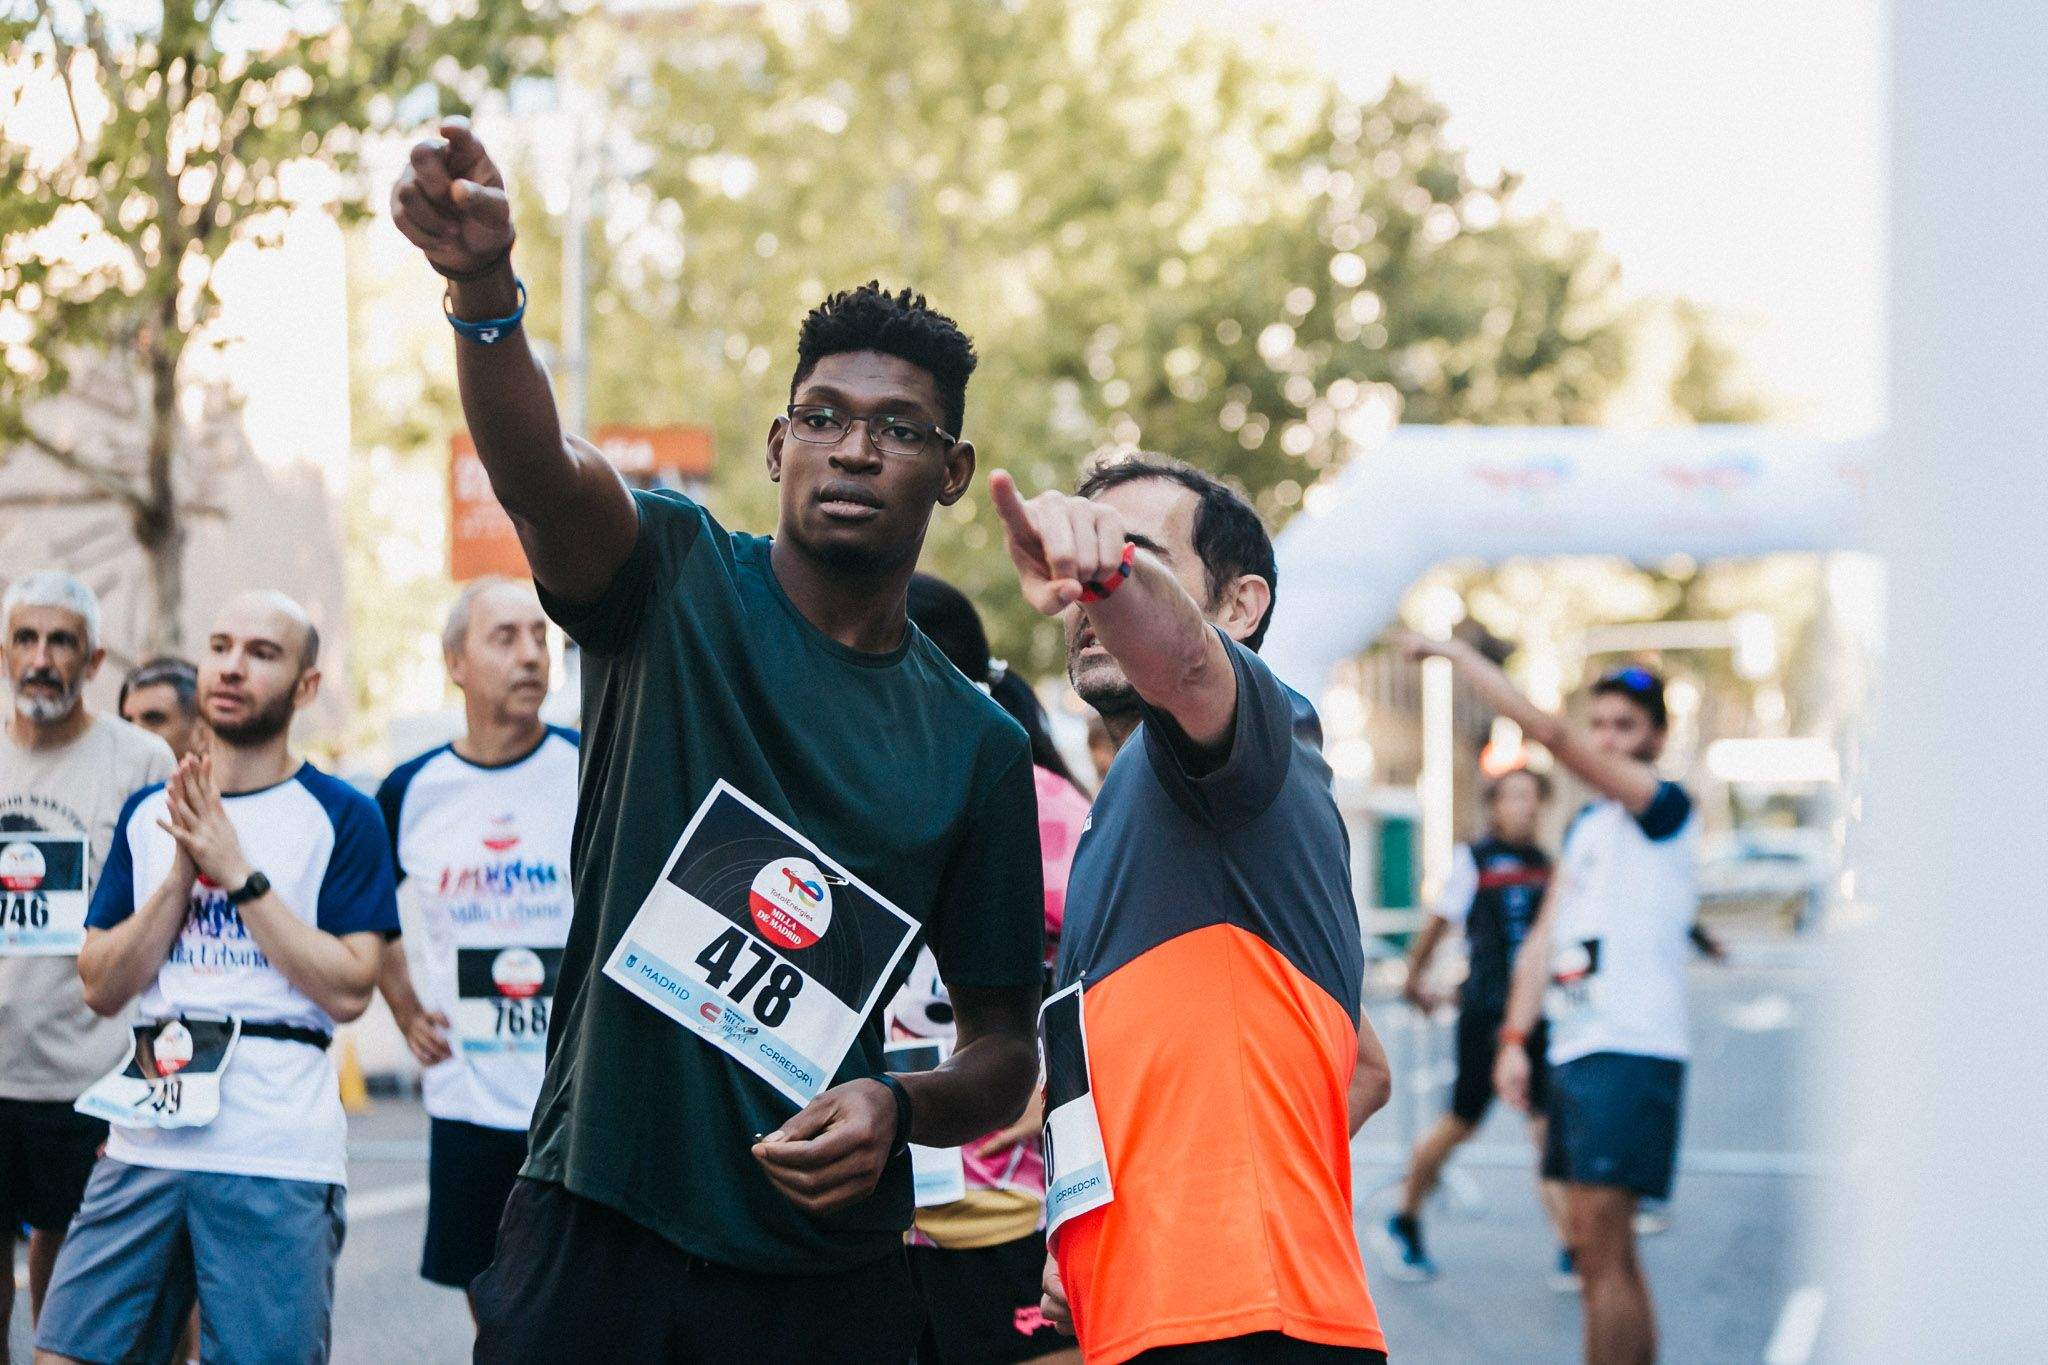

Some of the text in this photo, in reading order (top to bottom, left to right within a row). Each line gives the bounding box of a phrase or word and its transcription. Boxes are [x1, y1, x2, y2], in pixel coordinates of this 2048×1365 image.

[769, 888, 814, 922] TotalEnergies
[771, 908, 798, 931] MILLA
[756, 909, 802, 945] DE MADRID
[640, 964, 690, 1000] MADRID
[694, 925, 804, 1028] 478
[489, 997, 548, 1036] 768
